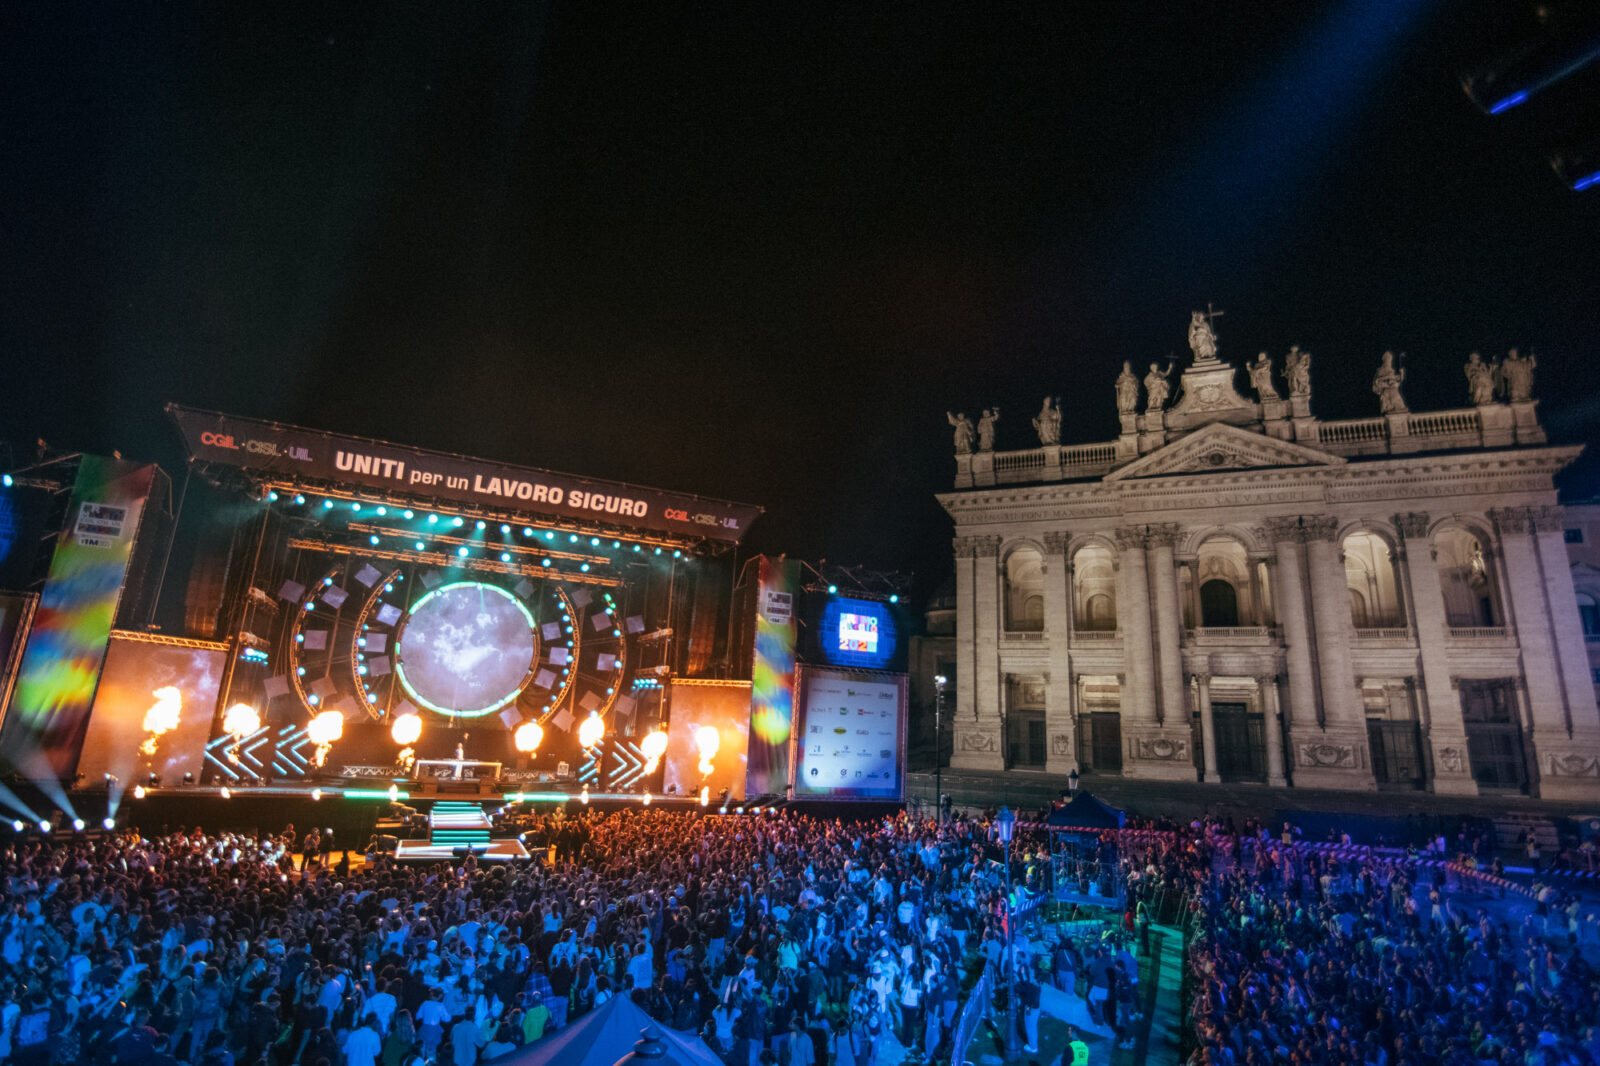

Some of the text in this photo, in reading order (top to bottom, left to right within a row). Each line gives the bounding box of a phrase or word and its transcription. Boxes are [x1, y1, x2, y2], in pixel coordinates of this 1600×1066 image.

[201, 432, 313, 461] CGIL CISL UIL
[335, 451, 648, 517] UNITI per un LAVORO SICURO
[664, 508, 739, 529] CGIL CISL UIL
